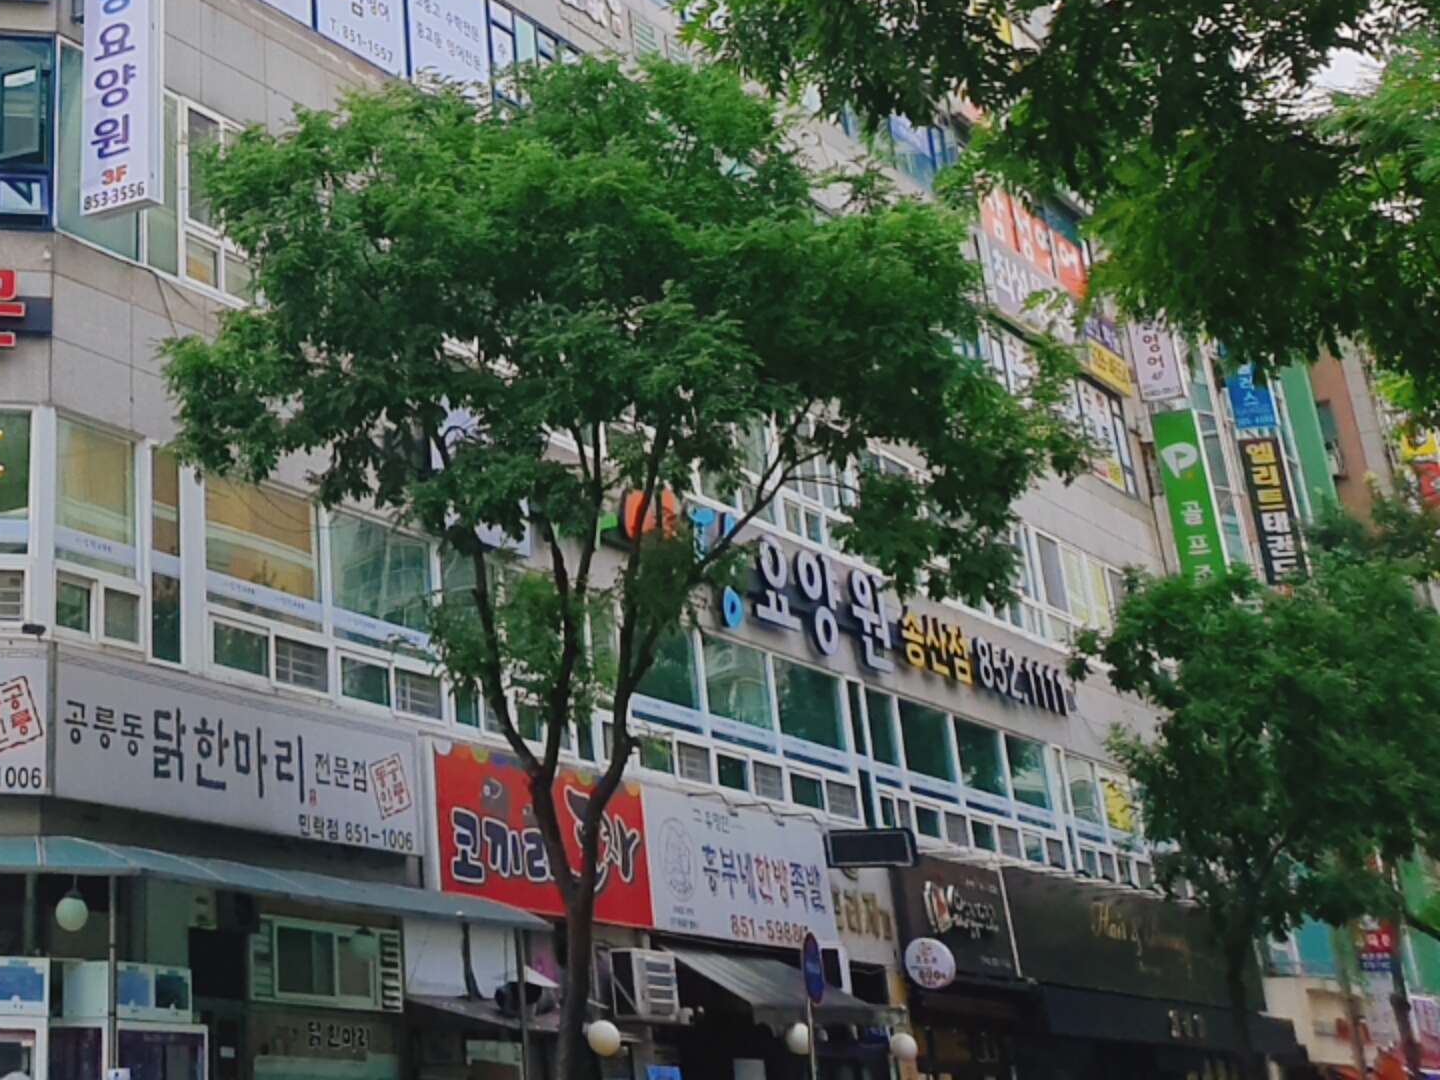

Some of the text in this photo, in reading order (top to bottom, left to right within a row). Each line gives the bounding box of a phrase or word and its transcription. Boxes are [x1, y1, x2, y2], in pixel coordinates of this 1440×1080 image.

[101, 164, 129, 188] 3F
[900, 611, 974, 687] 송산점
[63, 699, 368, 805] 공릉동 닭한마리 전문점
[297, 813, 414, 852] 민락점 851-1006
